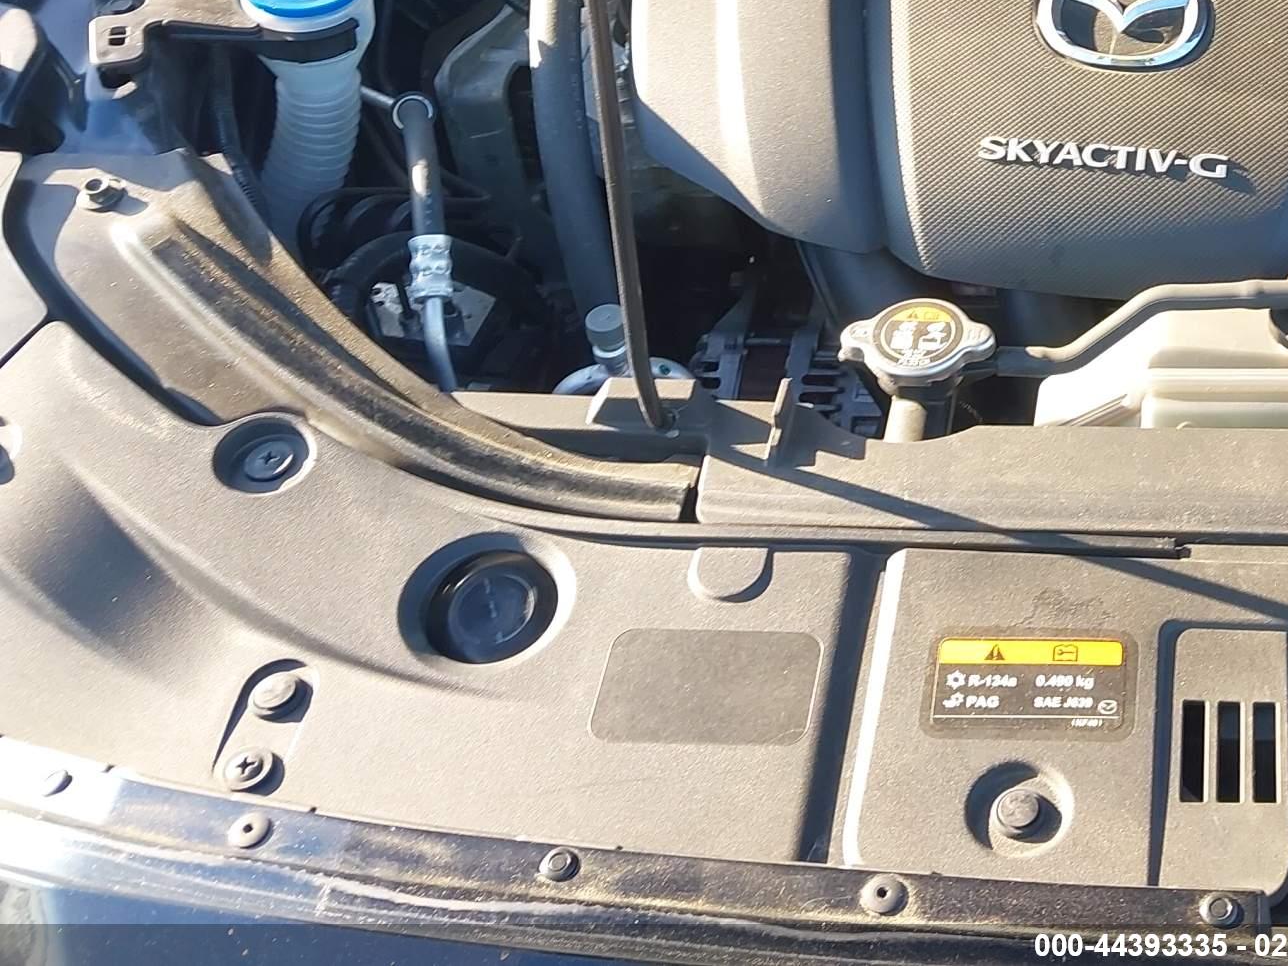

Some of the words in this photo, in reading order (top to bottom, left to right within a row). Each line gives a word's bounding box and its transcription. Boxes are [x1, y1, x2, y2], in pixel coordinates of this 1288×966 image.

[977, 136, 1230, 179] SKYACTIV-G
[967, 674, 1018, 689] R-134a
[1075, 674, 1095, 690] kg
[965, 695, 1000, 709] PAG
[1033, 696, 1062, 708] SAE
